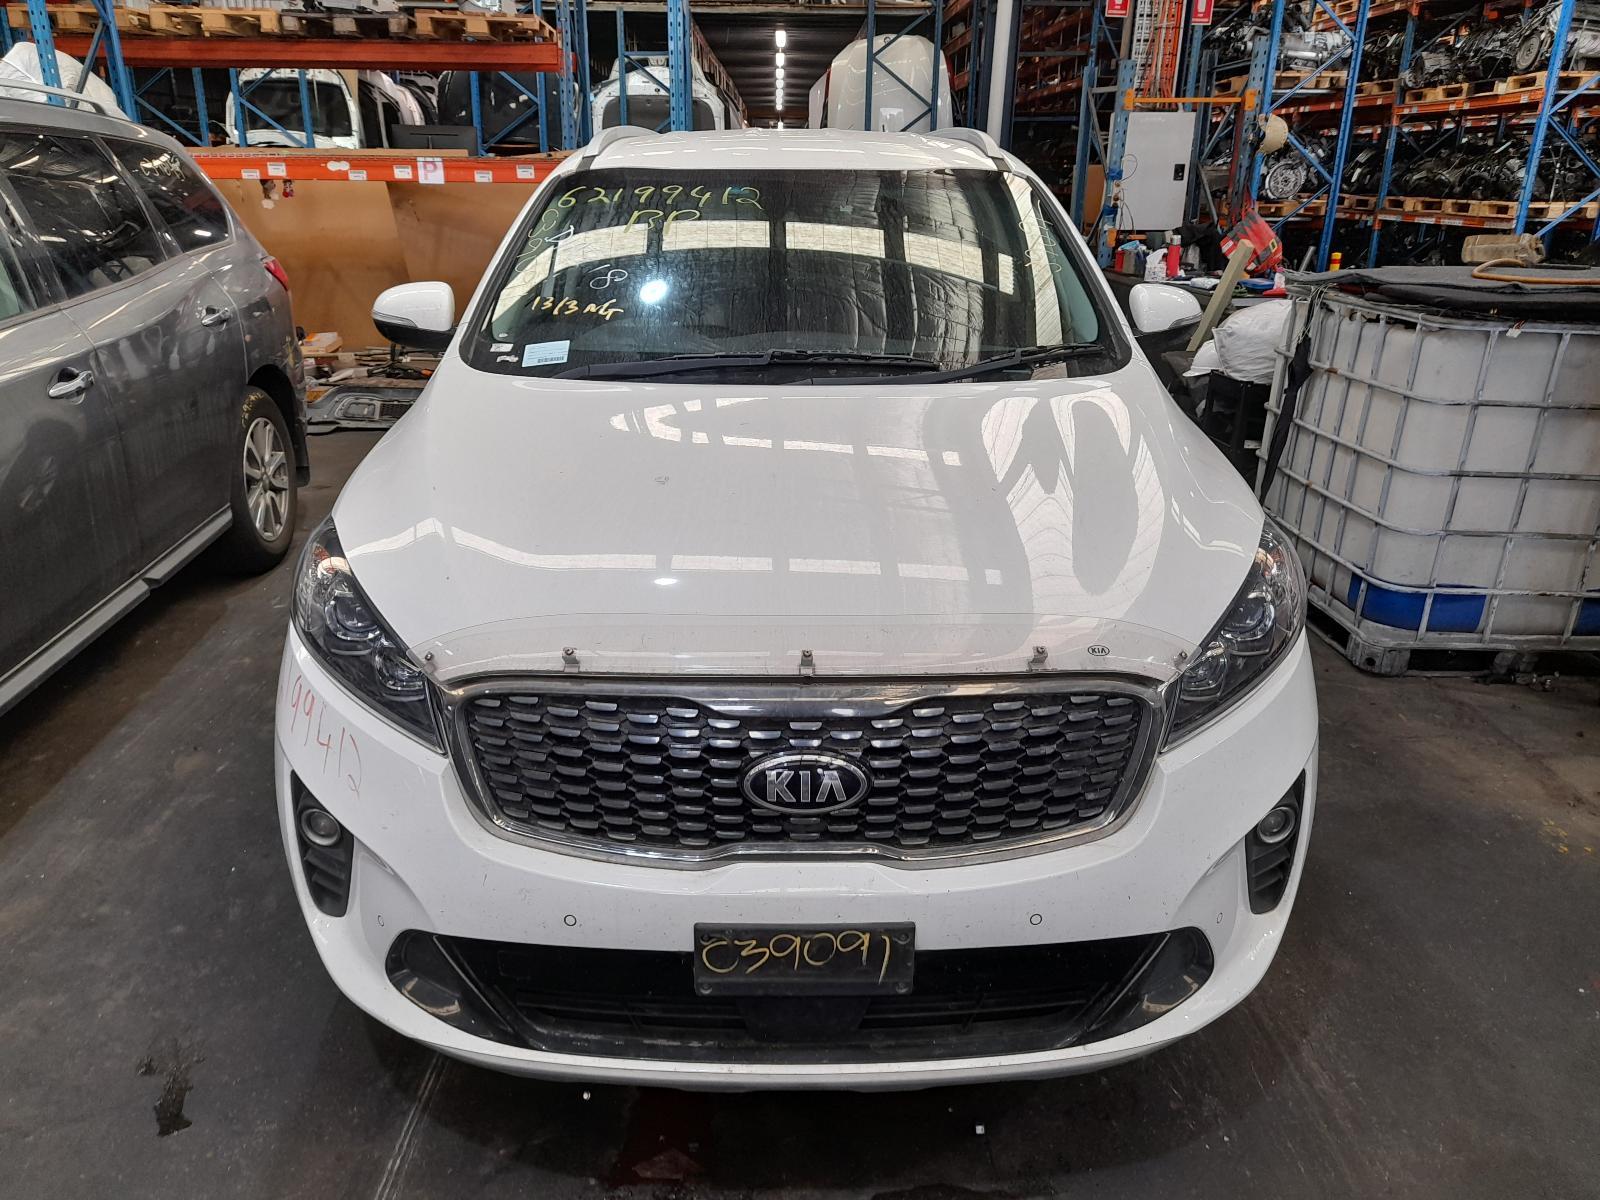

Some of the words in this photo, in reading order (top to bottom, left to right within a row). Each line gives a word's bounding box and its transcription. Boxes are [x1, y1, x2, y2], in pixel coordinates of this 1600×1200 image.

[558, 185, 764, 210] 62199412
[765, 769, 848, 803] KIA
[701, 930, 891, 985] C39091
